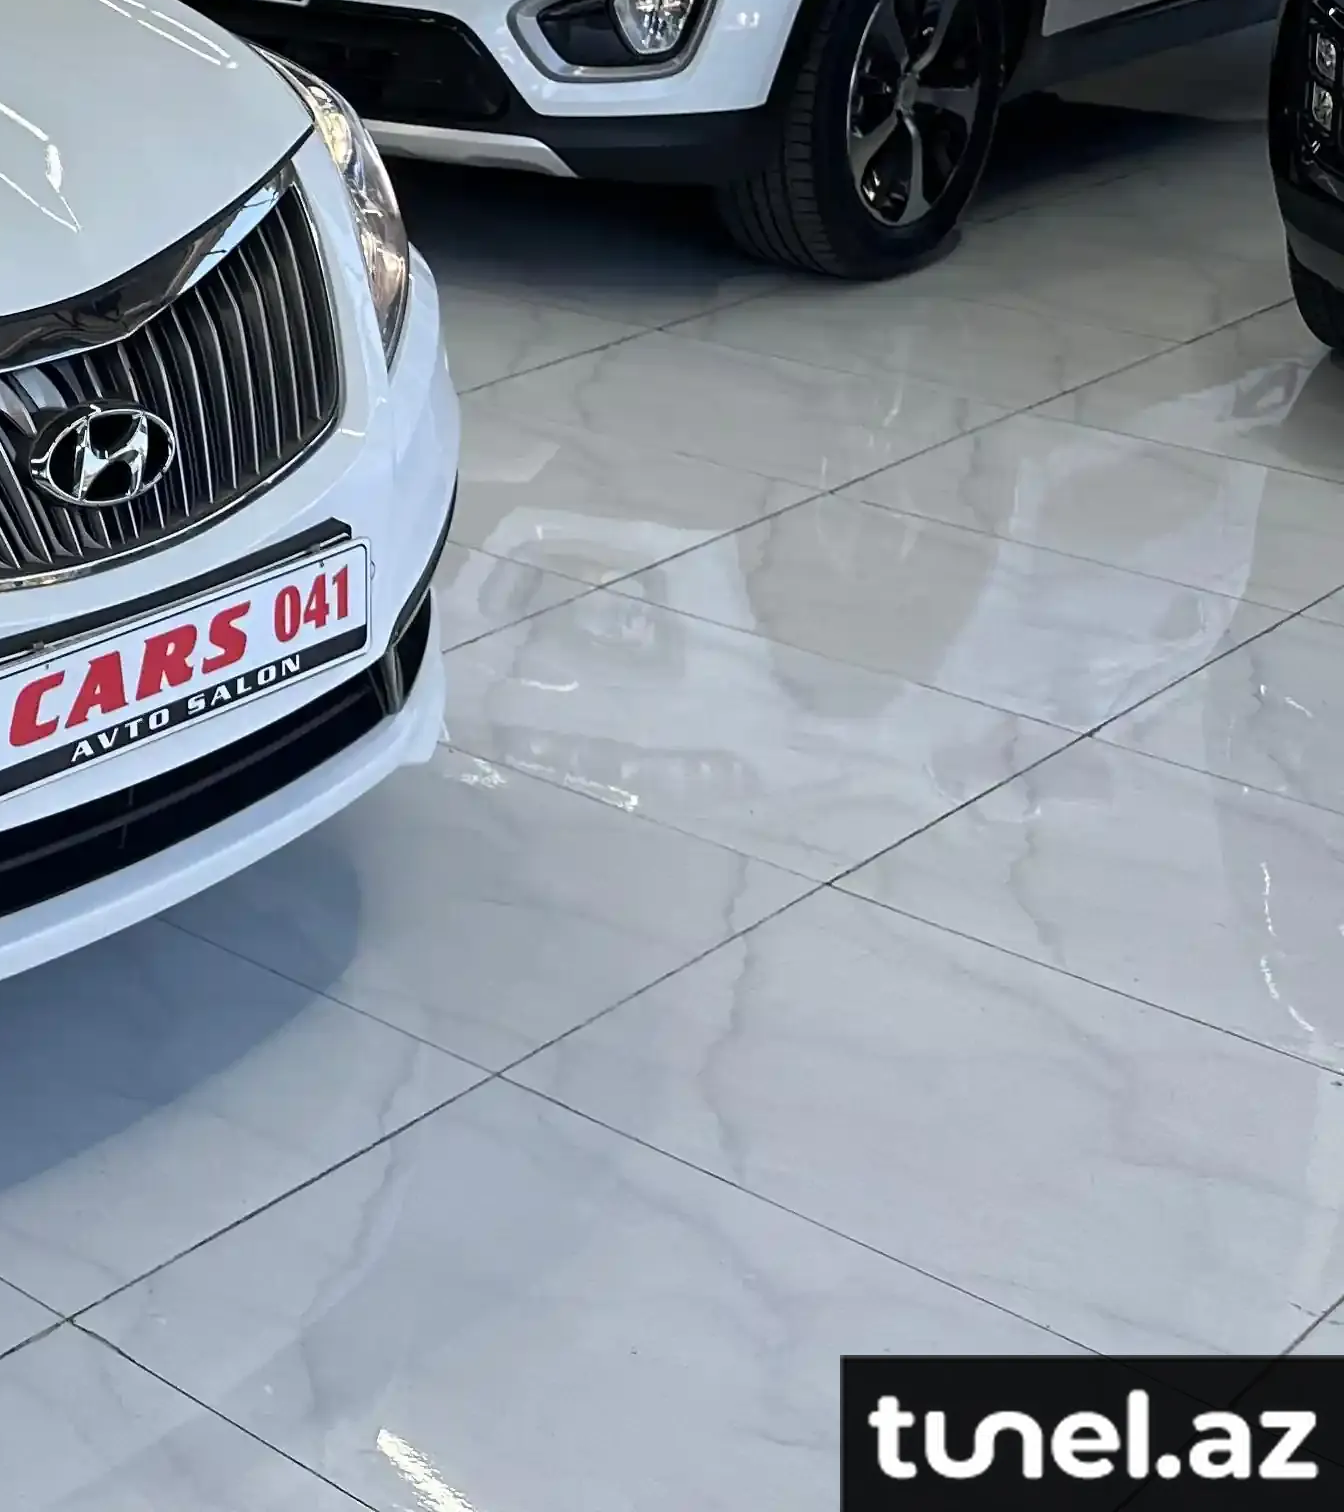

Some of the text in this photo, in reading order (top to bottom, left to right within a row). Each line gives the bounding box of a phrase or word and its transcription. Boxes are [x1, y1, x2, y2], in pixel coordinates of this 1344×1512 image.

[9, 564, 349, 747] CARS 041
[71, 653, 301, 763] AVTO SALON
